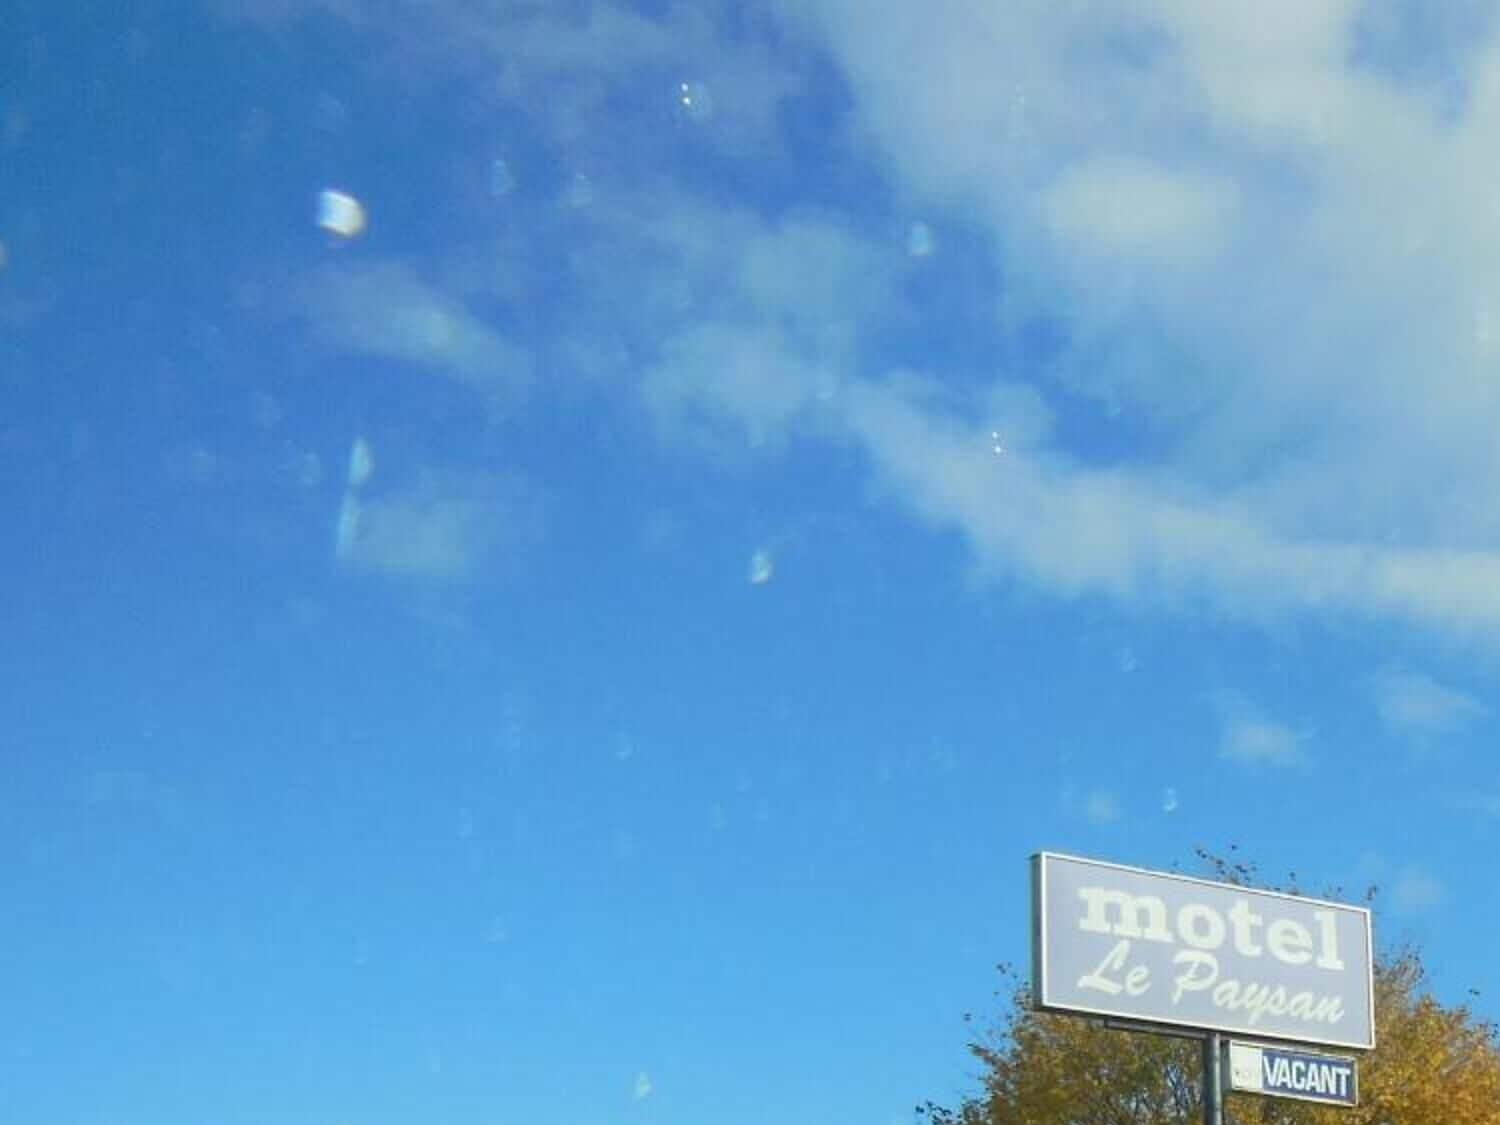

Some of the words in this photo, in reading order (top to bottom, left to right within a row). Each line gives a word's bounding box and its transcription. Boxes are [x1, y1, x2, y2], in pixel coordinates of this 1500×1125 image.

[1078, 886, 1345, 971] motel
[1077, 940, 1151, 996] Le
[1172, 949, 1345, 1025] Paysan
[1263, 1055, 1351, 1097] VACANT
